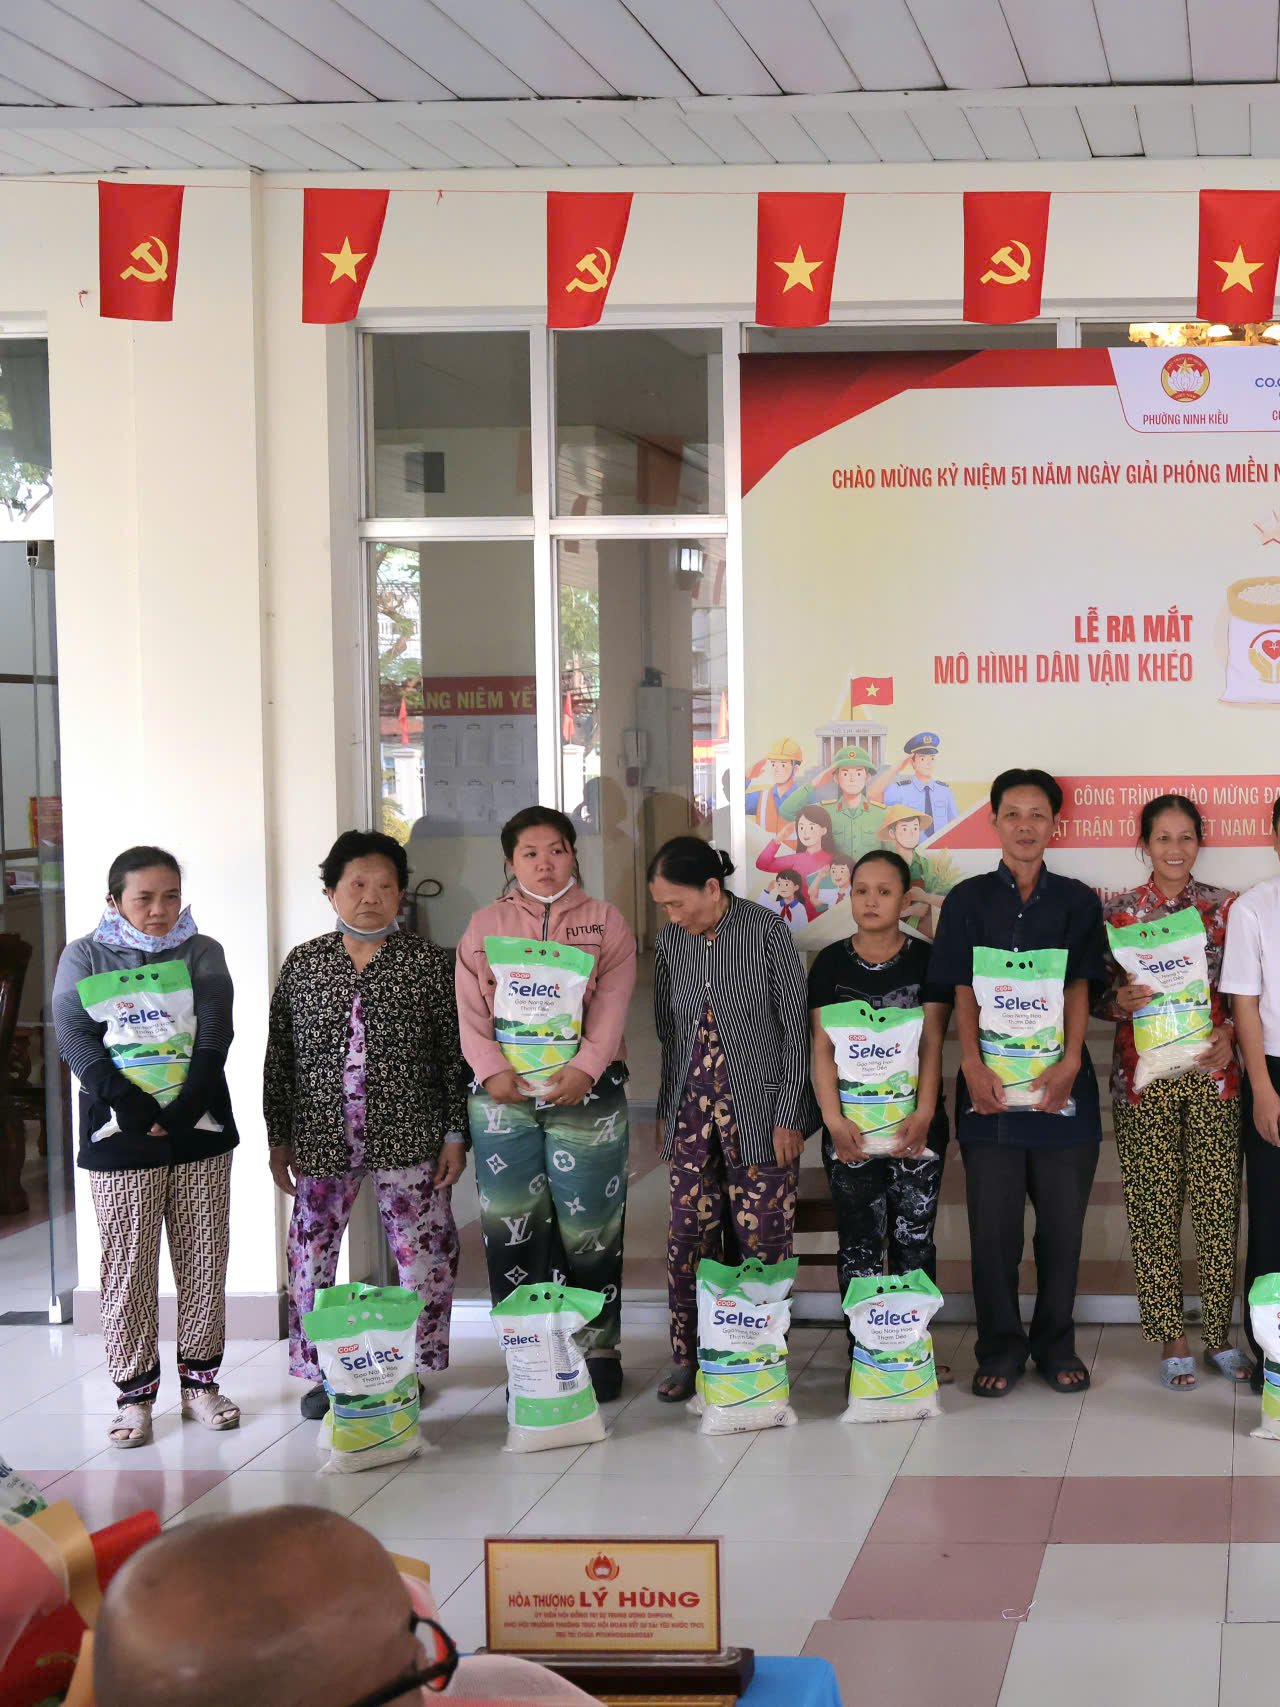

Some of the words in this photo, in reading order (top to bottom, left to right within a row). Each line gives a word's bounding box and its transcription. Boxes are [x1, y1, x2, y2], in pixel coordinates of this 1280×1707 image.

[1143, 412, 1181, 425] PHƯỜNG
[1183, 414, 1206, 424] NINH
[1208, 409, 1228, 424] KIỀU
[832, 465, 875, 489] CHÀO
[881, 463, 932, 487] MỪNG
[938, 462, 959, 486] KỶ
[964, 463, 1006, 489] NIỆM
[1011, 465, 1028, 485] 51
[1032, 462, 1071, 485] NĂM
[1077, 462, 1120, 484] NGÀY
[1126, 461, 1158, 484] GIẢI
[1164, 460, 1220, 484] PHÓNG
[1226, 455, 1268, 483] MIỀN
[1075, 606, 1100, 643] LỄ
[1107, 615, 1136, 643] RA
[1144, 605, 1193, 643] MẮT
[934, 651, 969, 684] MÔ
[977, 651, 1028, 684] HÌNH
[1036, 650, 1080, 683] DÂN
[1088, 650, 1129, 687] VẬN
[1138, 649, 1193, 682] KHÉO
[457, 687, 504, 709] NIÊM
[509, 687, 536, 708] YẾ
[1074, 784, 1115, 806] CÔNG
[1213, 784, 1259, 806] MỪNG
[1073, 816, 1113, 841] TRẬN
[1118, 811, 1136, 837] TỔ
[1221, 819, 1256, 837] NAM
[509, 981, 561, 998] Select
[993, 996, 1048, 1011] Select
[849, 1043, 901, 1059] Select
[713, 1310, 771, 1328] Select
[868, 1308, 920, 1326] Select
[338, 1344, 359, 1354] COOP
[503, 1334, 540, 1345] Select
[340, 1347, 404, 1371] Select
[508, 1591, 531, 1607] HÒA
[533, 1593, 575, 1610] THƯỢNG
[580, 1586, 608, 1607] LÝ
[619, 1586, 701, 1608] HÙNG
